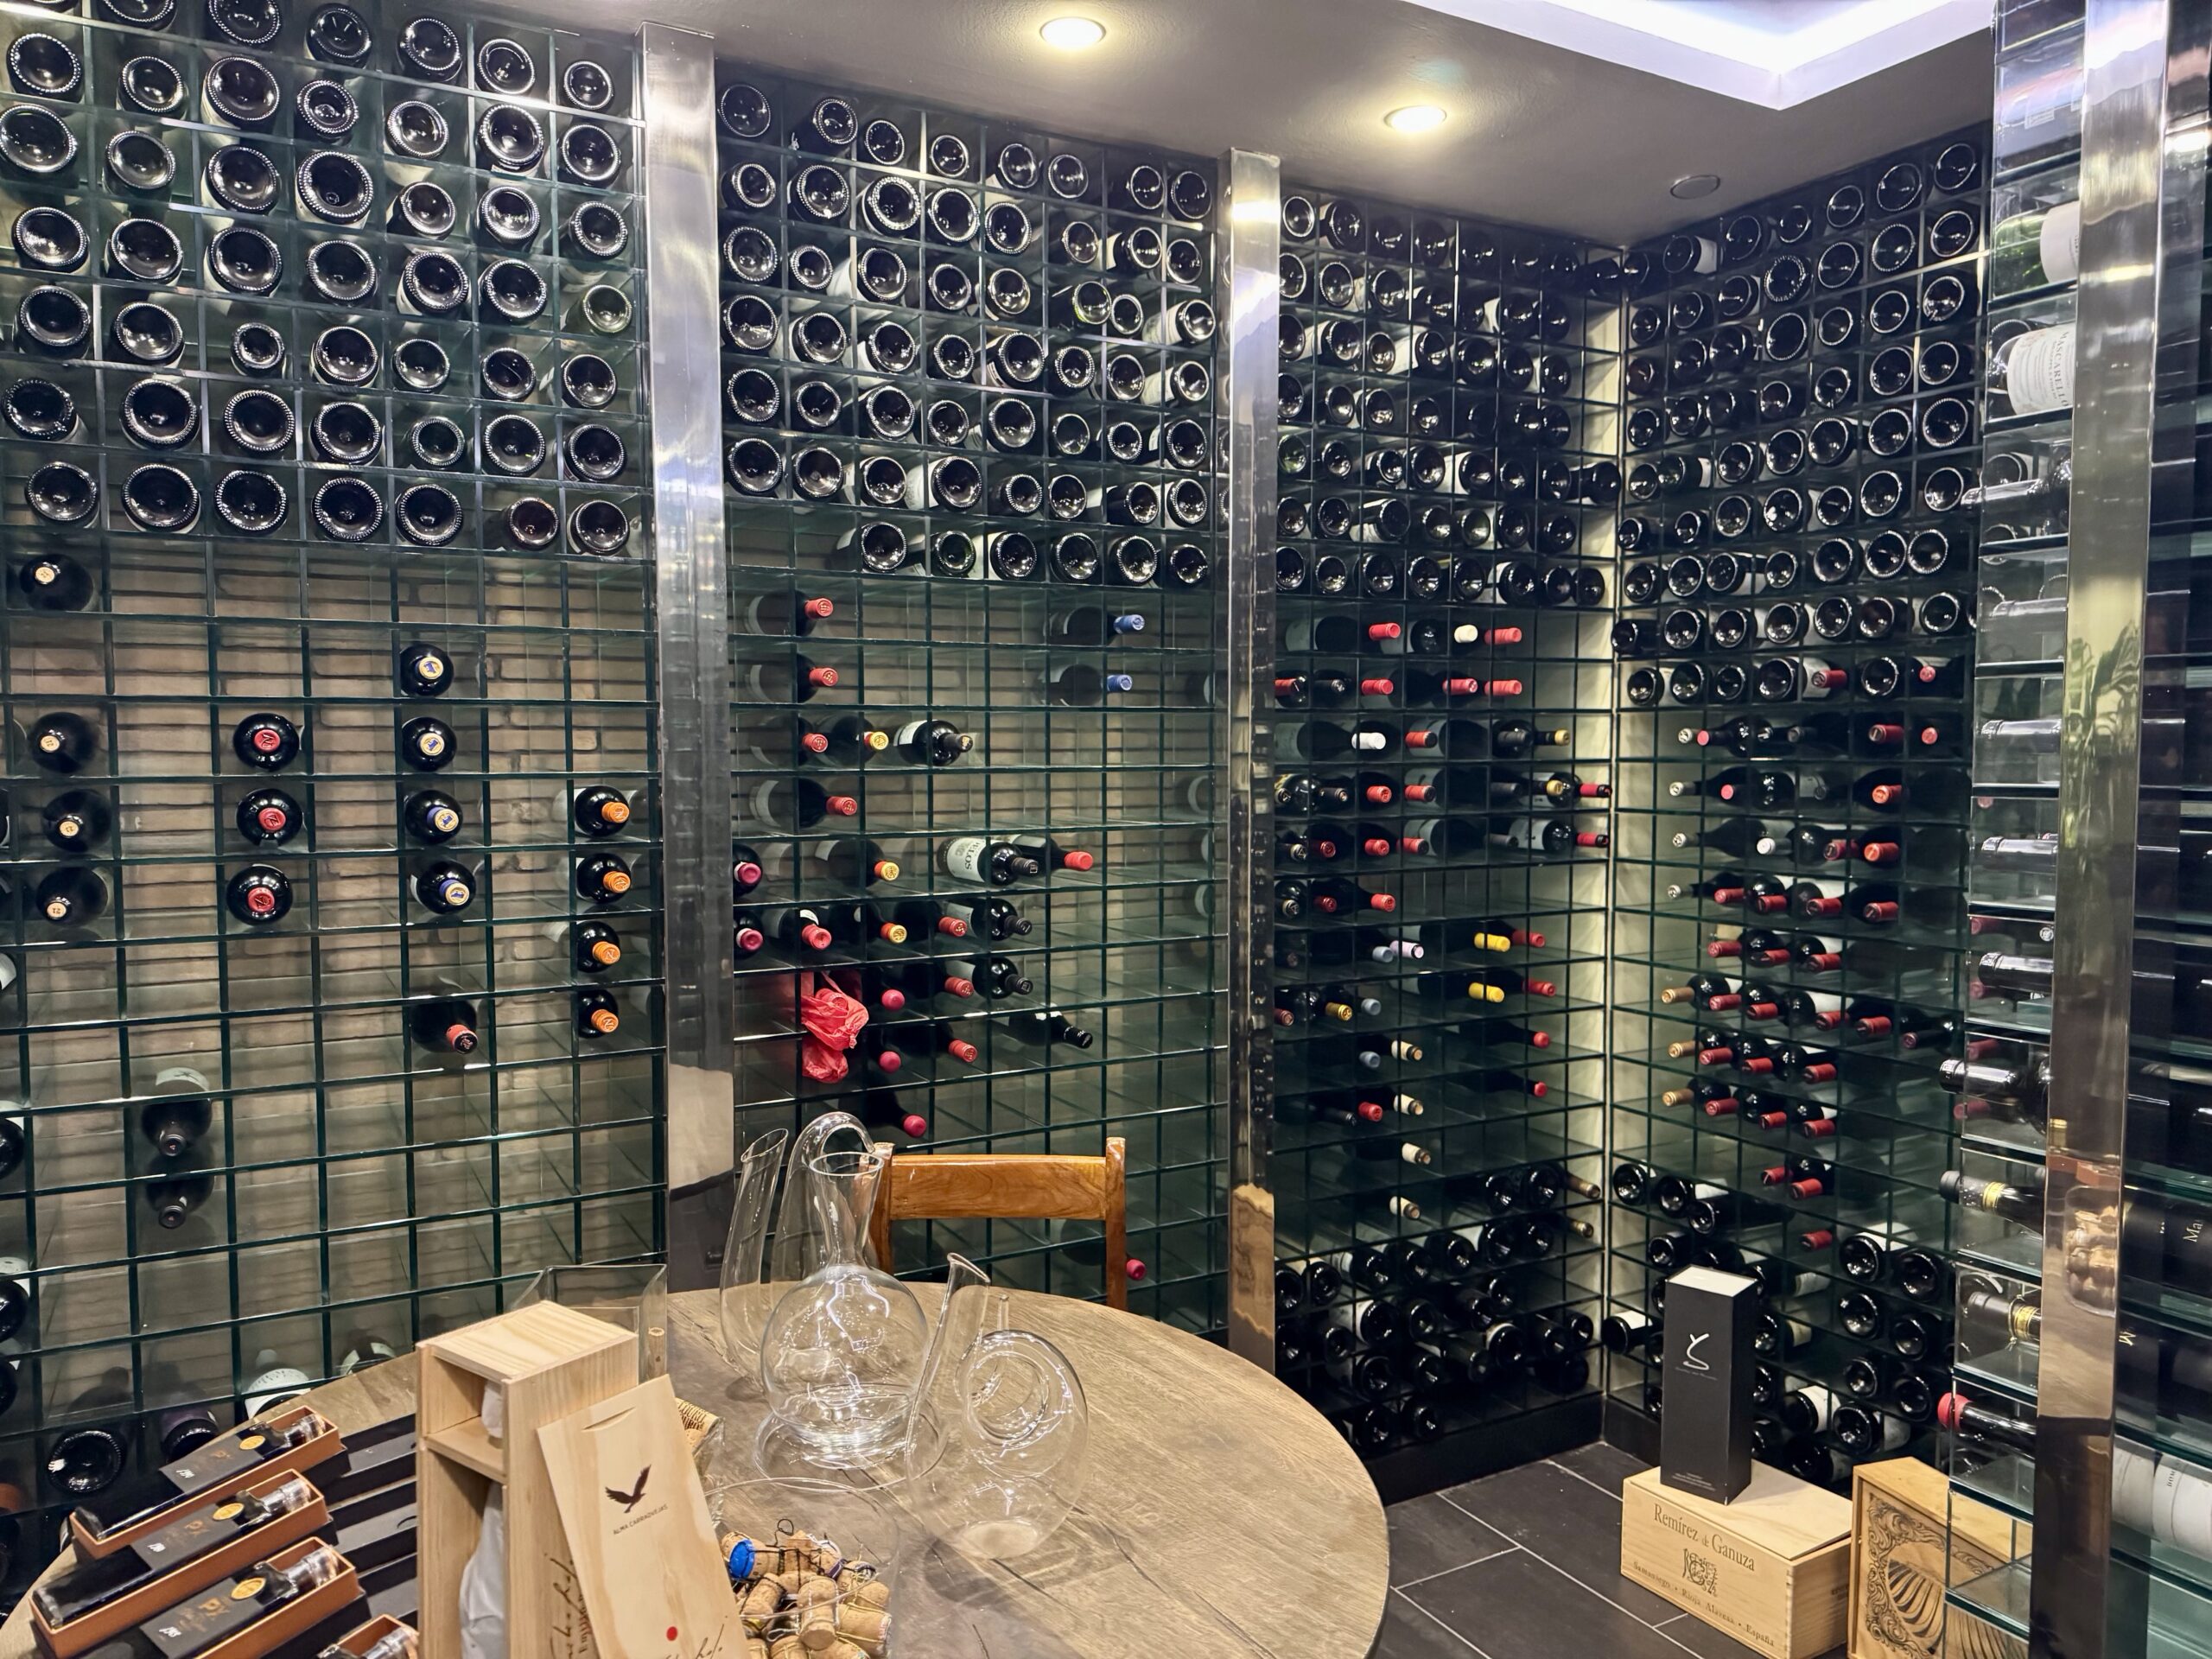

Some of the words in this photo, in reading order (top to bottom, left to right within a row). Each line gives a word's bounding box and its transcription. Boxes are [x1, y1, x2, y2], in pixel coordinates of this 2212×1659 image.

[2053, 331, 2069, 407] MASCARELLO
[613, 1524, 628, 1535] ALMA
[1654, 1503, 1699, 1542] Remírez
[1712, 1534, 1755, 1571] Ganuza
[1746, 1624, 1775, 1647] España
